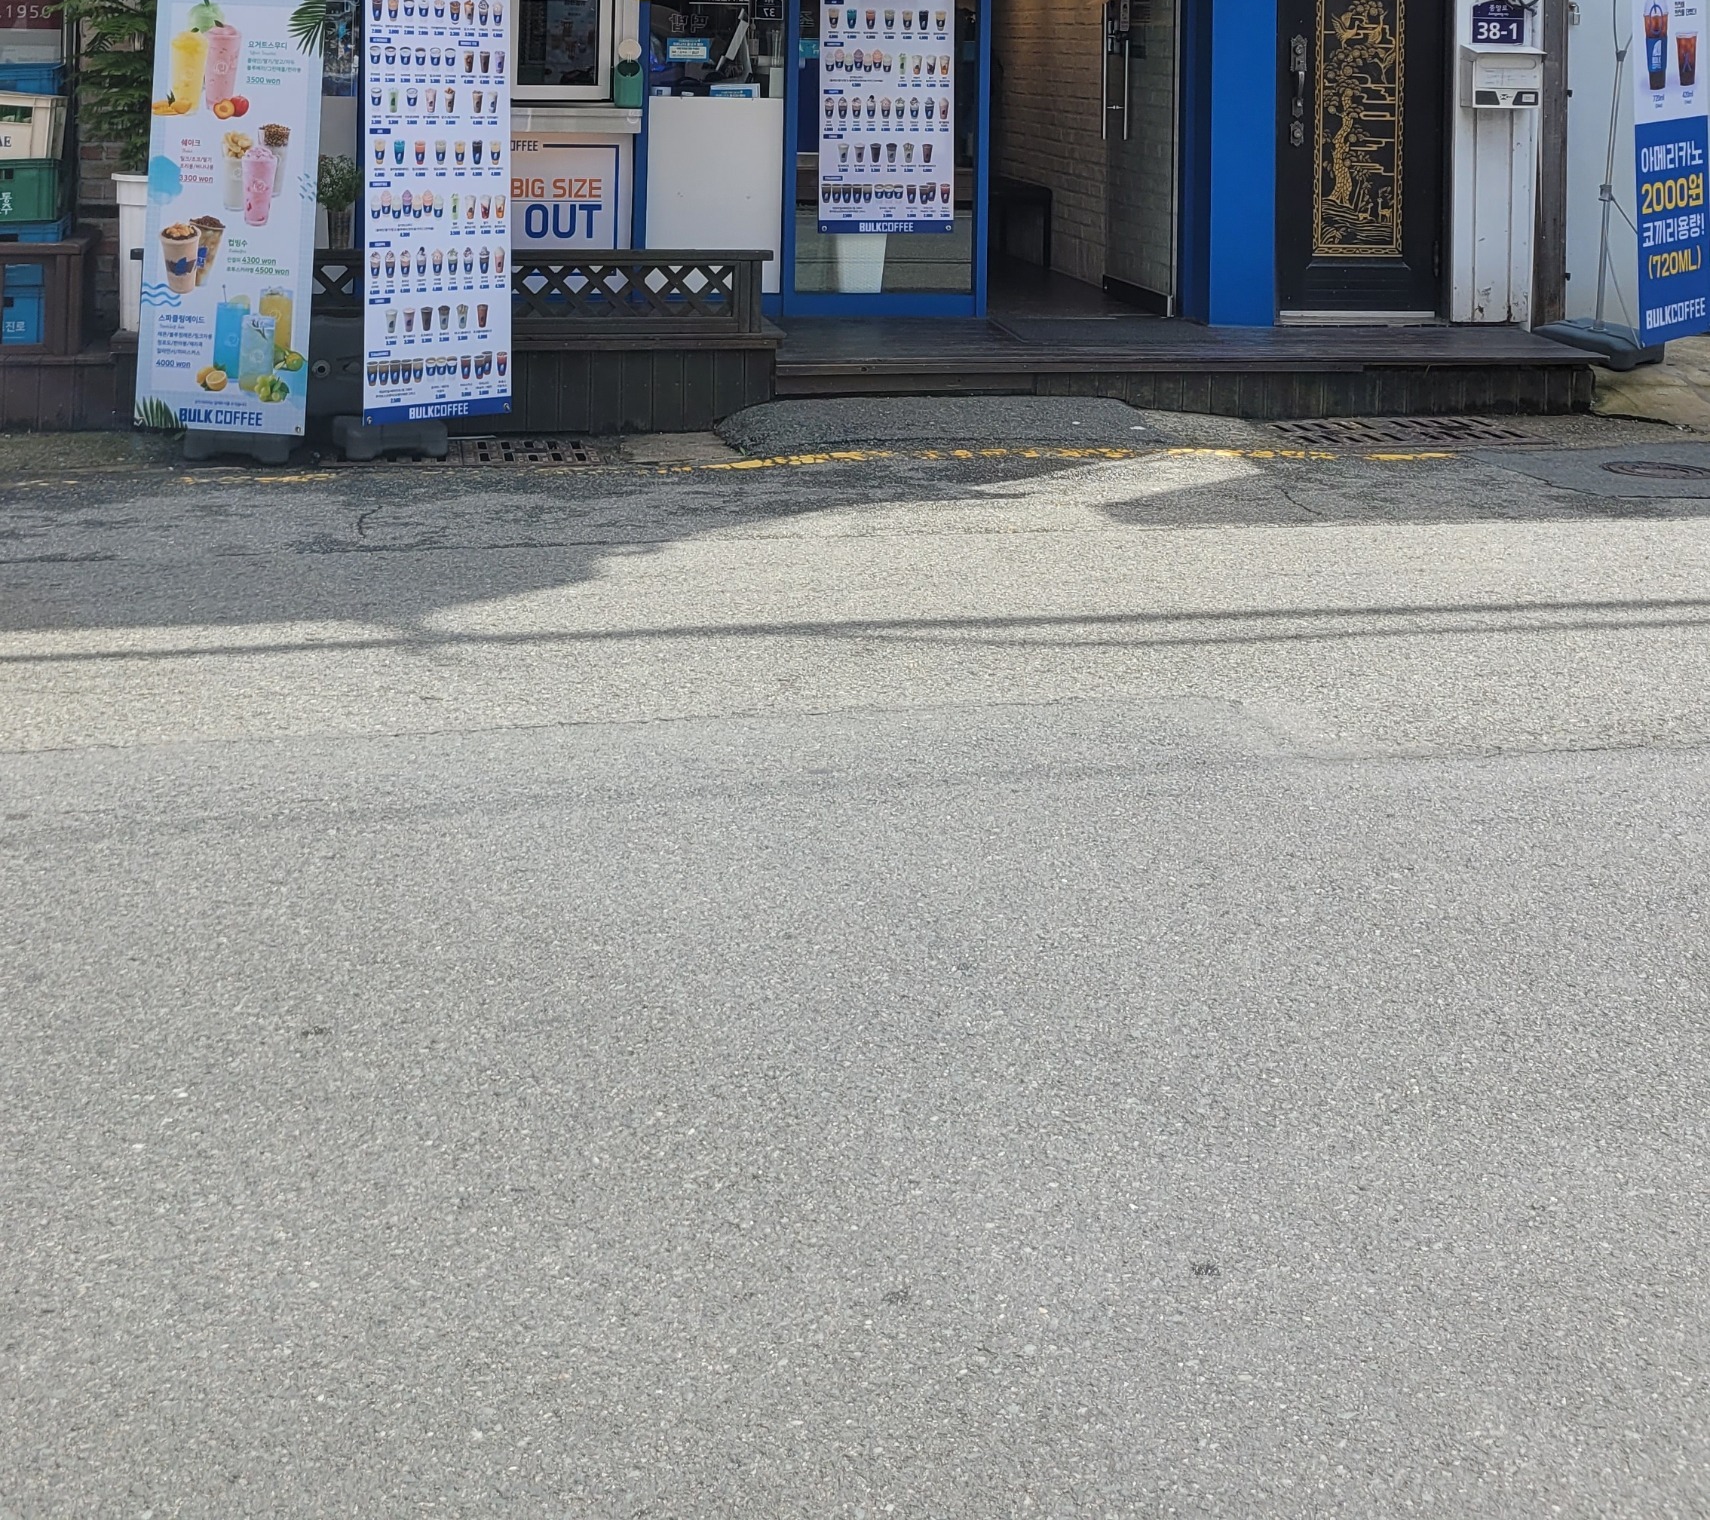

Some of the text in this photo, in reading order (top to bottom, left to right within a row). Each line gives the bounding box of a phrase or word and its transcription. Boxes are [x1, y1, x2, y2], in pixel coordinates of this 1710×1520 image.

[1477, 22, 1518, 40] 38-1
[1641, 140, 1704, 173] 아메리카노
[510, 178, 602, 199] BIG SIZE
[1641, 172, 1704, 215] 2000원
[524, 203, 602, 239] OUT
[859, 222, 914, 233] BULKCOFFEE
[1642, 212, 1706, 247] 코끼리용량!
[1648, 244, 1702, 280] (720ML)
[1646, 297, 1707, 331] BULKCOFFEE
[408, 402, 469, 420] BULKCOFFEE
